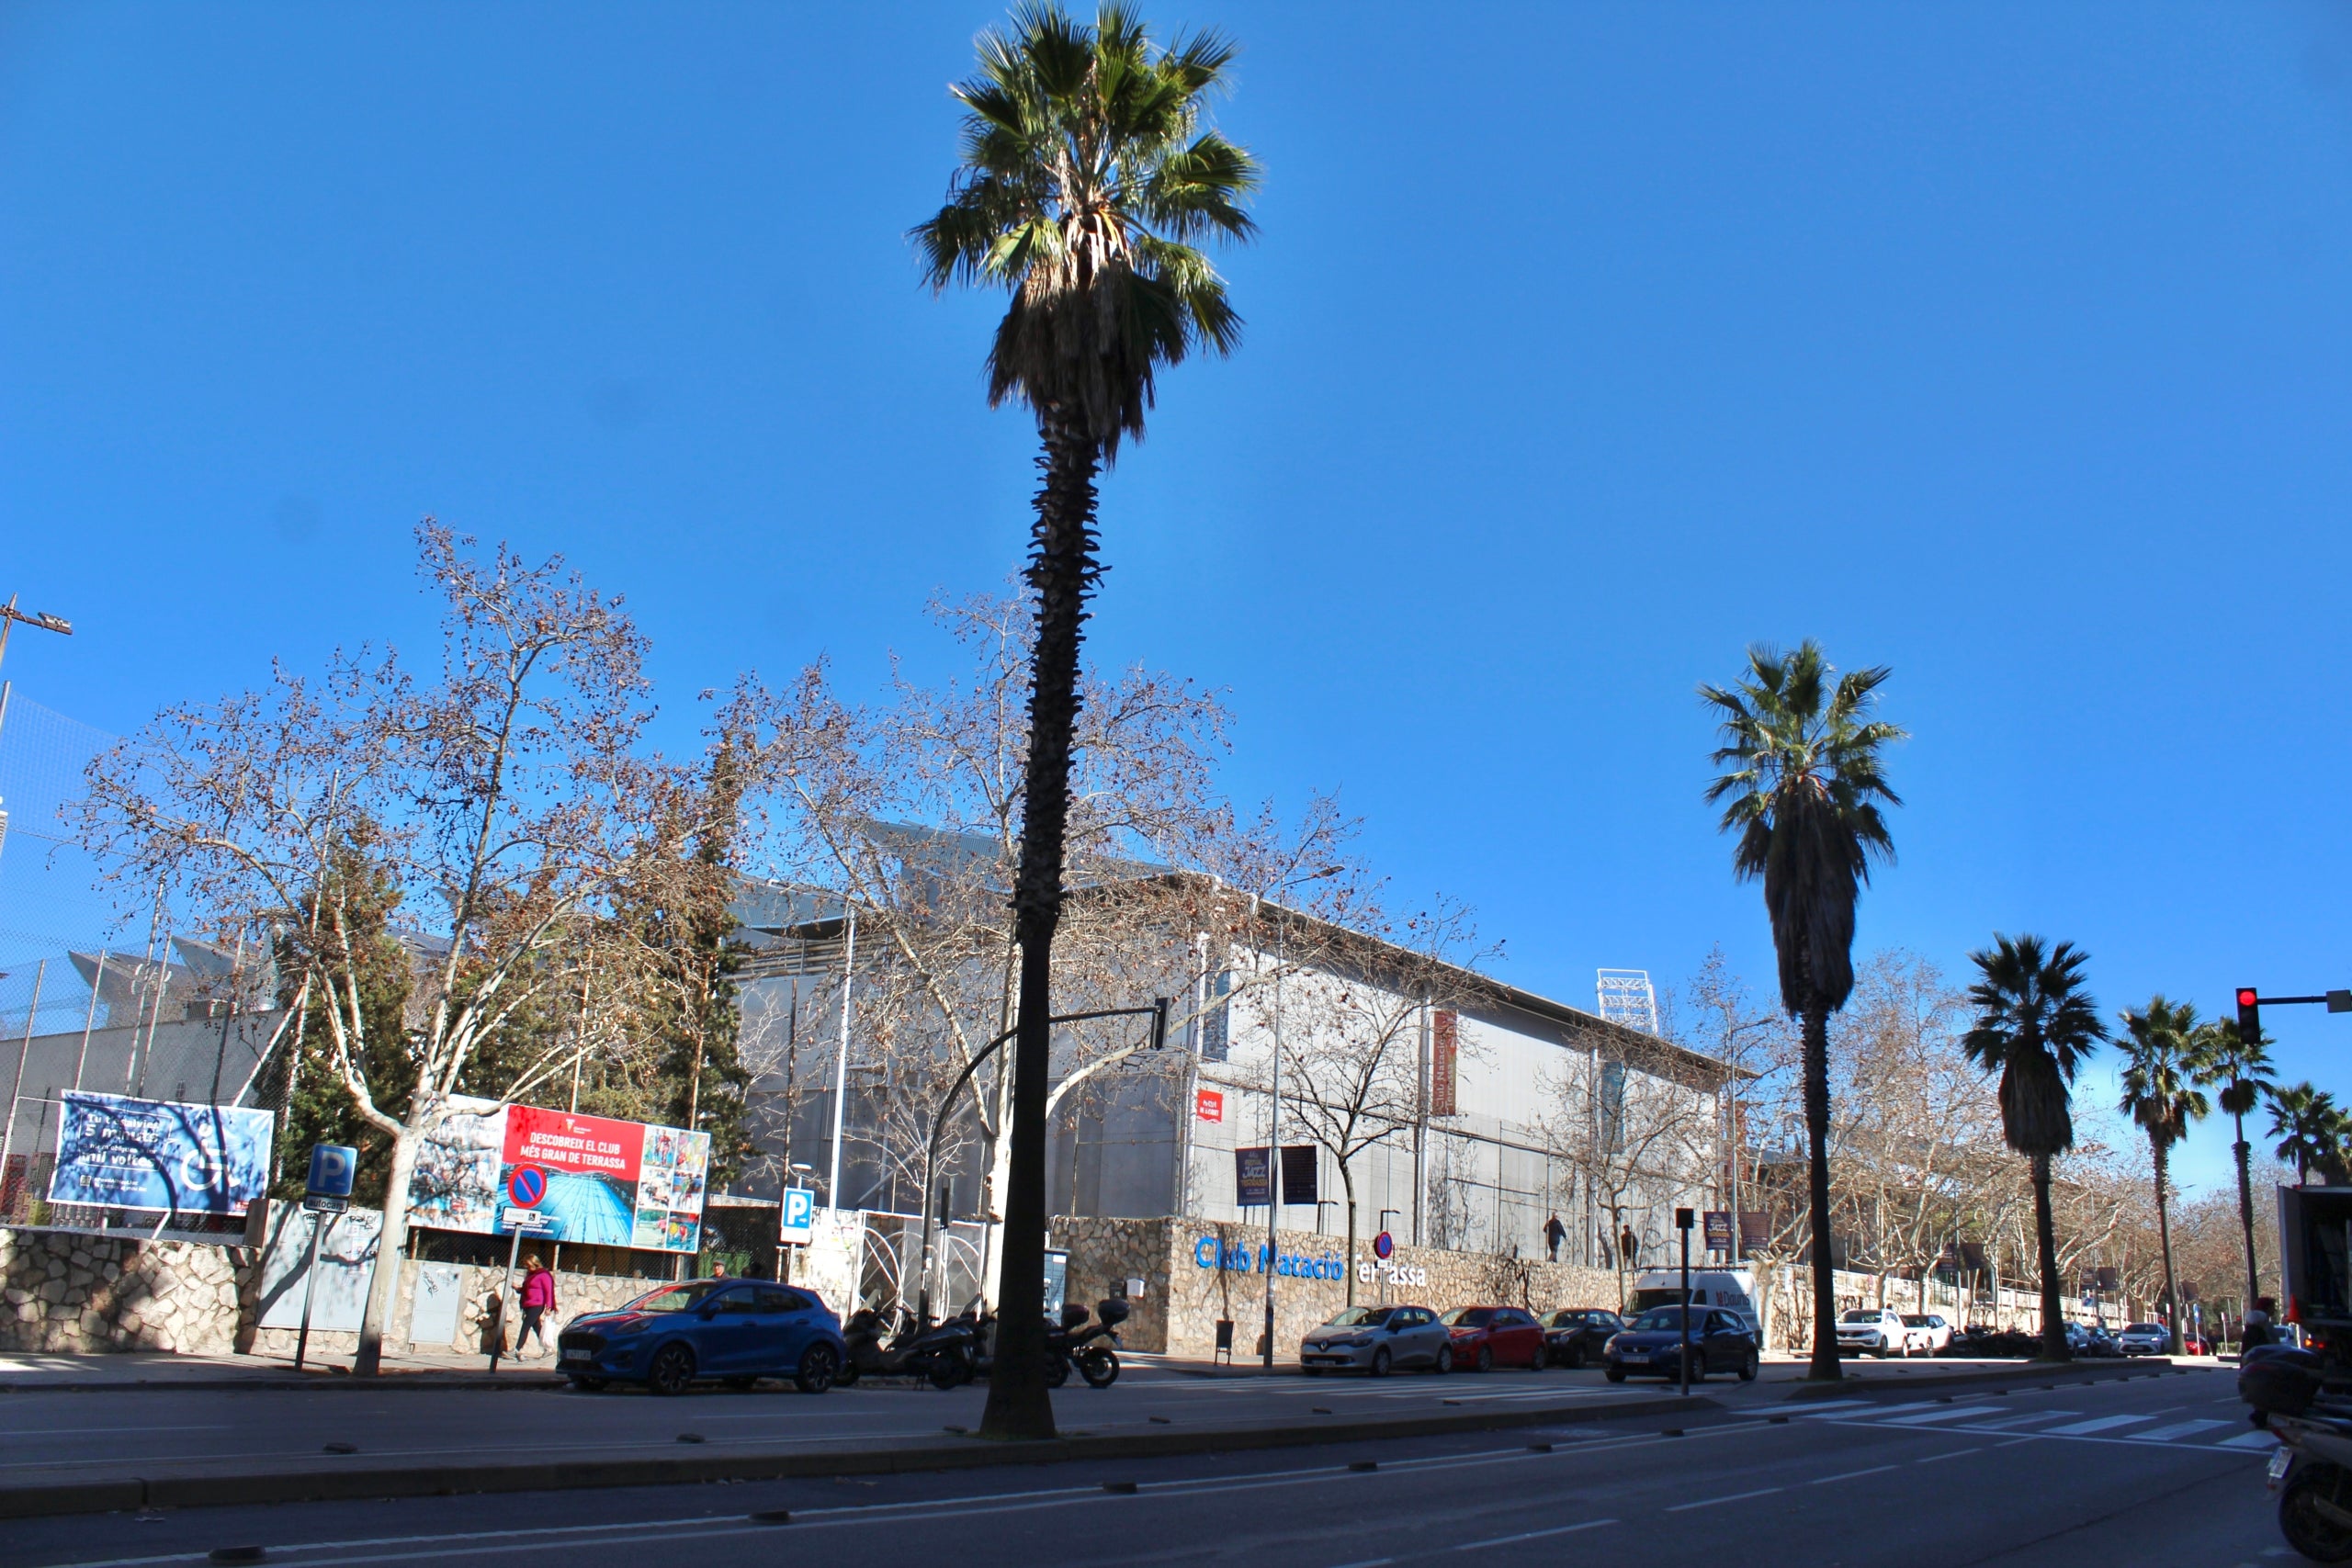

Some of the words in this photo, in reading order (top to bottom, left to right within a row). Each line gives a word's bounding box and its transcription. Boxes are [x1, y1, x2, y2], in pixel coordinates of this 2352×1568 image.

[85, 1123, 96, 1136] 5
[530, 1132, 584, 1149] DESCOBREIX
[585, 1140, 596, 1152] EL
[597, 1142, 620, 1155] CLUB
[520, 1145, 540, 1158] MÉS
[541, 1147, 567, 1162] GRAN
[568, 1152, 581, 1164] DE
[582, 1154, 626, 1169] TERRASSA
[317, 1151, 345, 1188] P
[1242, 1165, 1267, 1179] JAZZ
[308, 1198, 345, 1210] autocars
[787, 1193, 808, 1224] P
[1195, 1235, 1251, 1272] Club
[1259, 1244, 1344, 1280] Natació
